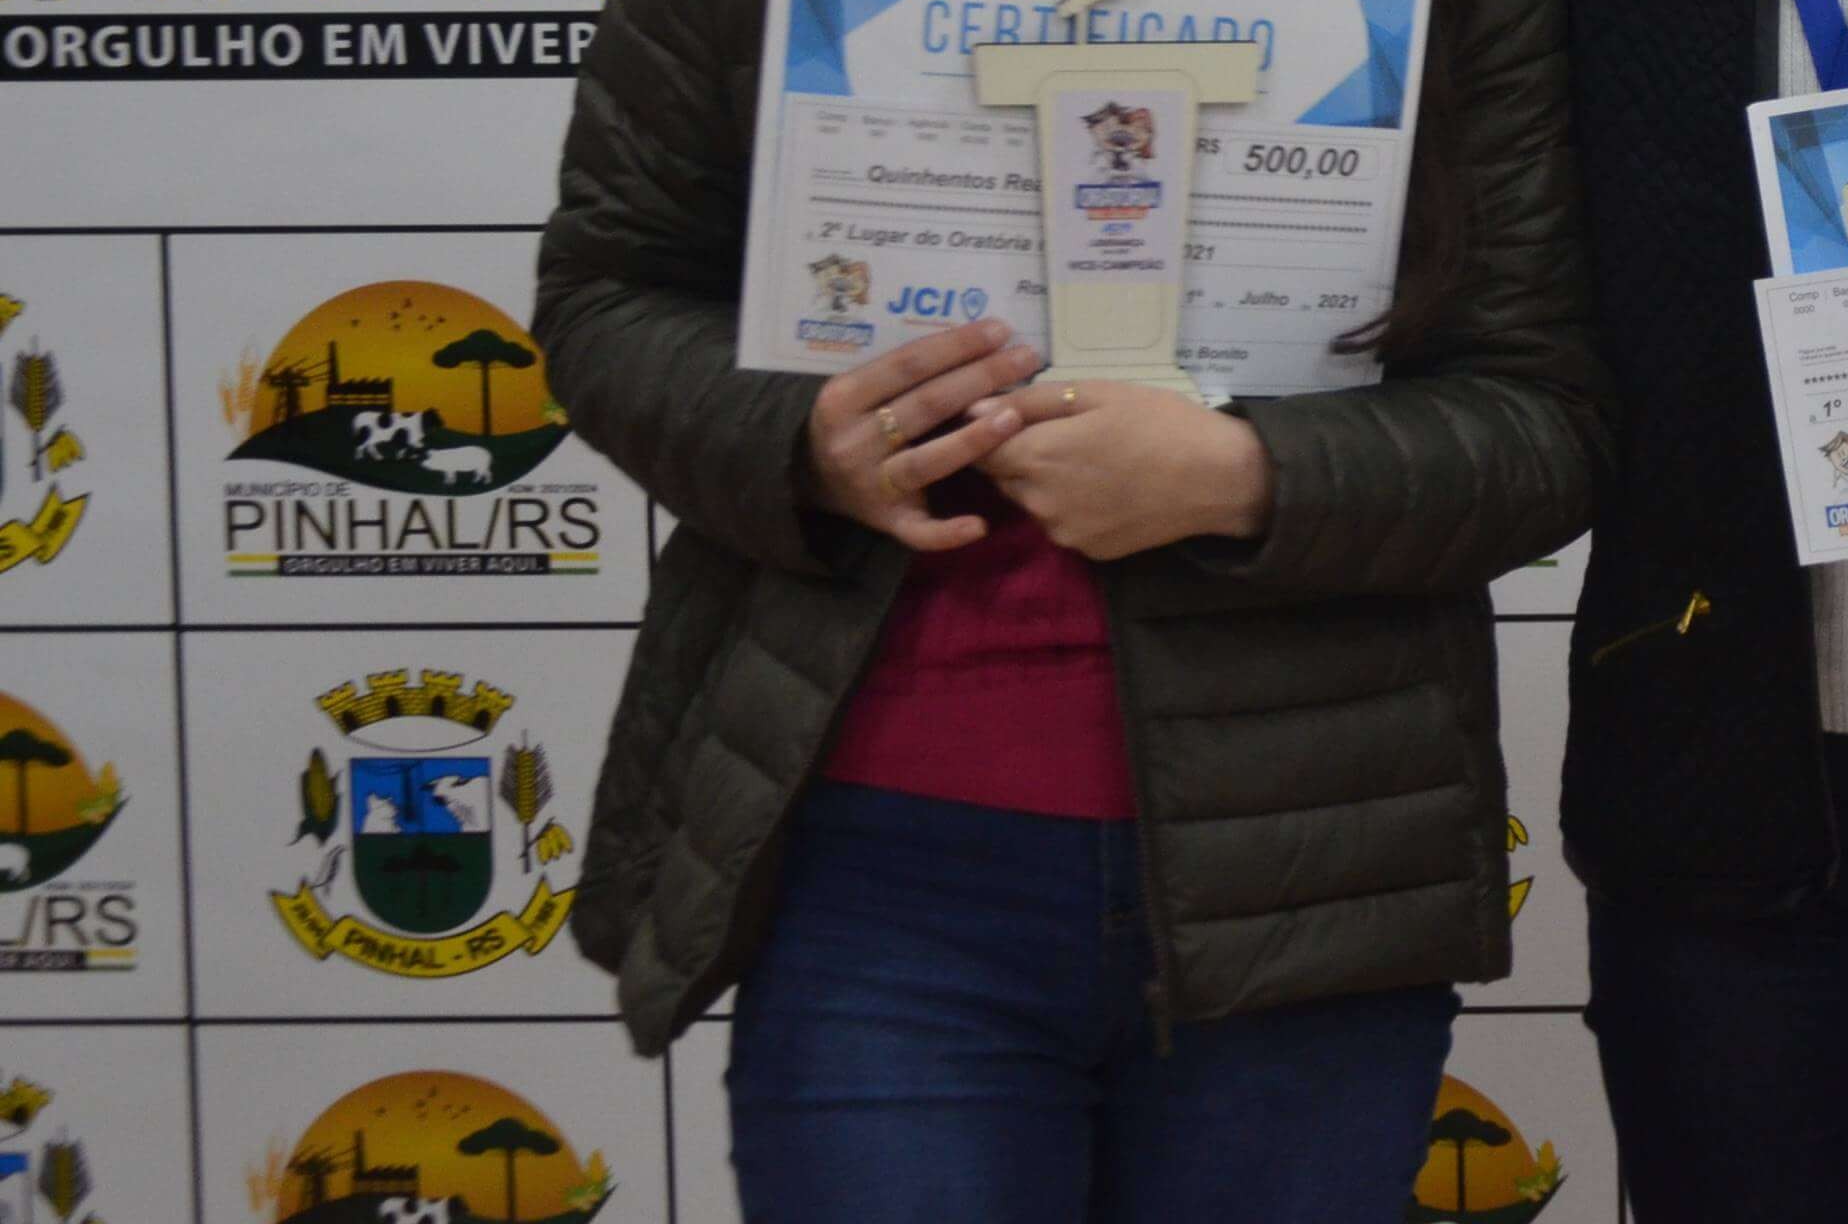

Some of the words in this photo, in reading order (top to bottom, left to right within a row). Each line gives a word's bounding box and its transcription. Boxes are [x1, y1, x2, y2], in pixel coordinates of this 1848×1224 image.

[5, 23, 302, 69] ORGULHO
[323, 24, 408, 67] EM
[1244, 144, 1360, 180] 500,00
[868, 165, 997, 190] Quinhentos
[847, 224, 909, 247] Lugar
[916, 230, 941, 247] do
[949, 230, 1032, 252] Oratória
[887, 287, 955, 317] JCI
[1239, 290, 1290, 307] Julho
[1317, 293, 1359, 309] 2021
[1198, 346, 1249, 360] Bonito
[1822, 399, 1842, 418] 1º
[325, 482, 351, 497] DE
[224, 496, 600, 551] PINHAL/RS
[389, 558, 416, 572] EM
[421, 557, 482, 572] VIVER
[466, 928, 505, 961] RS
